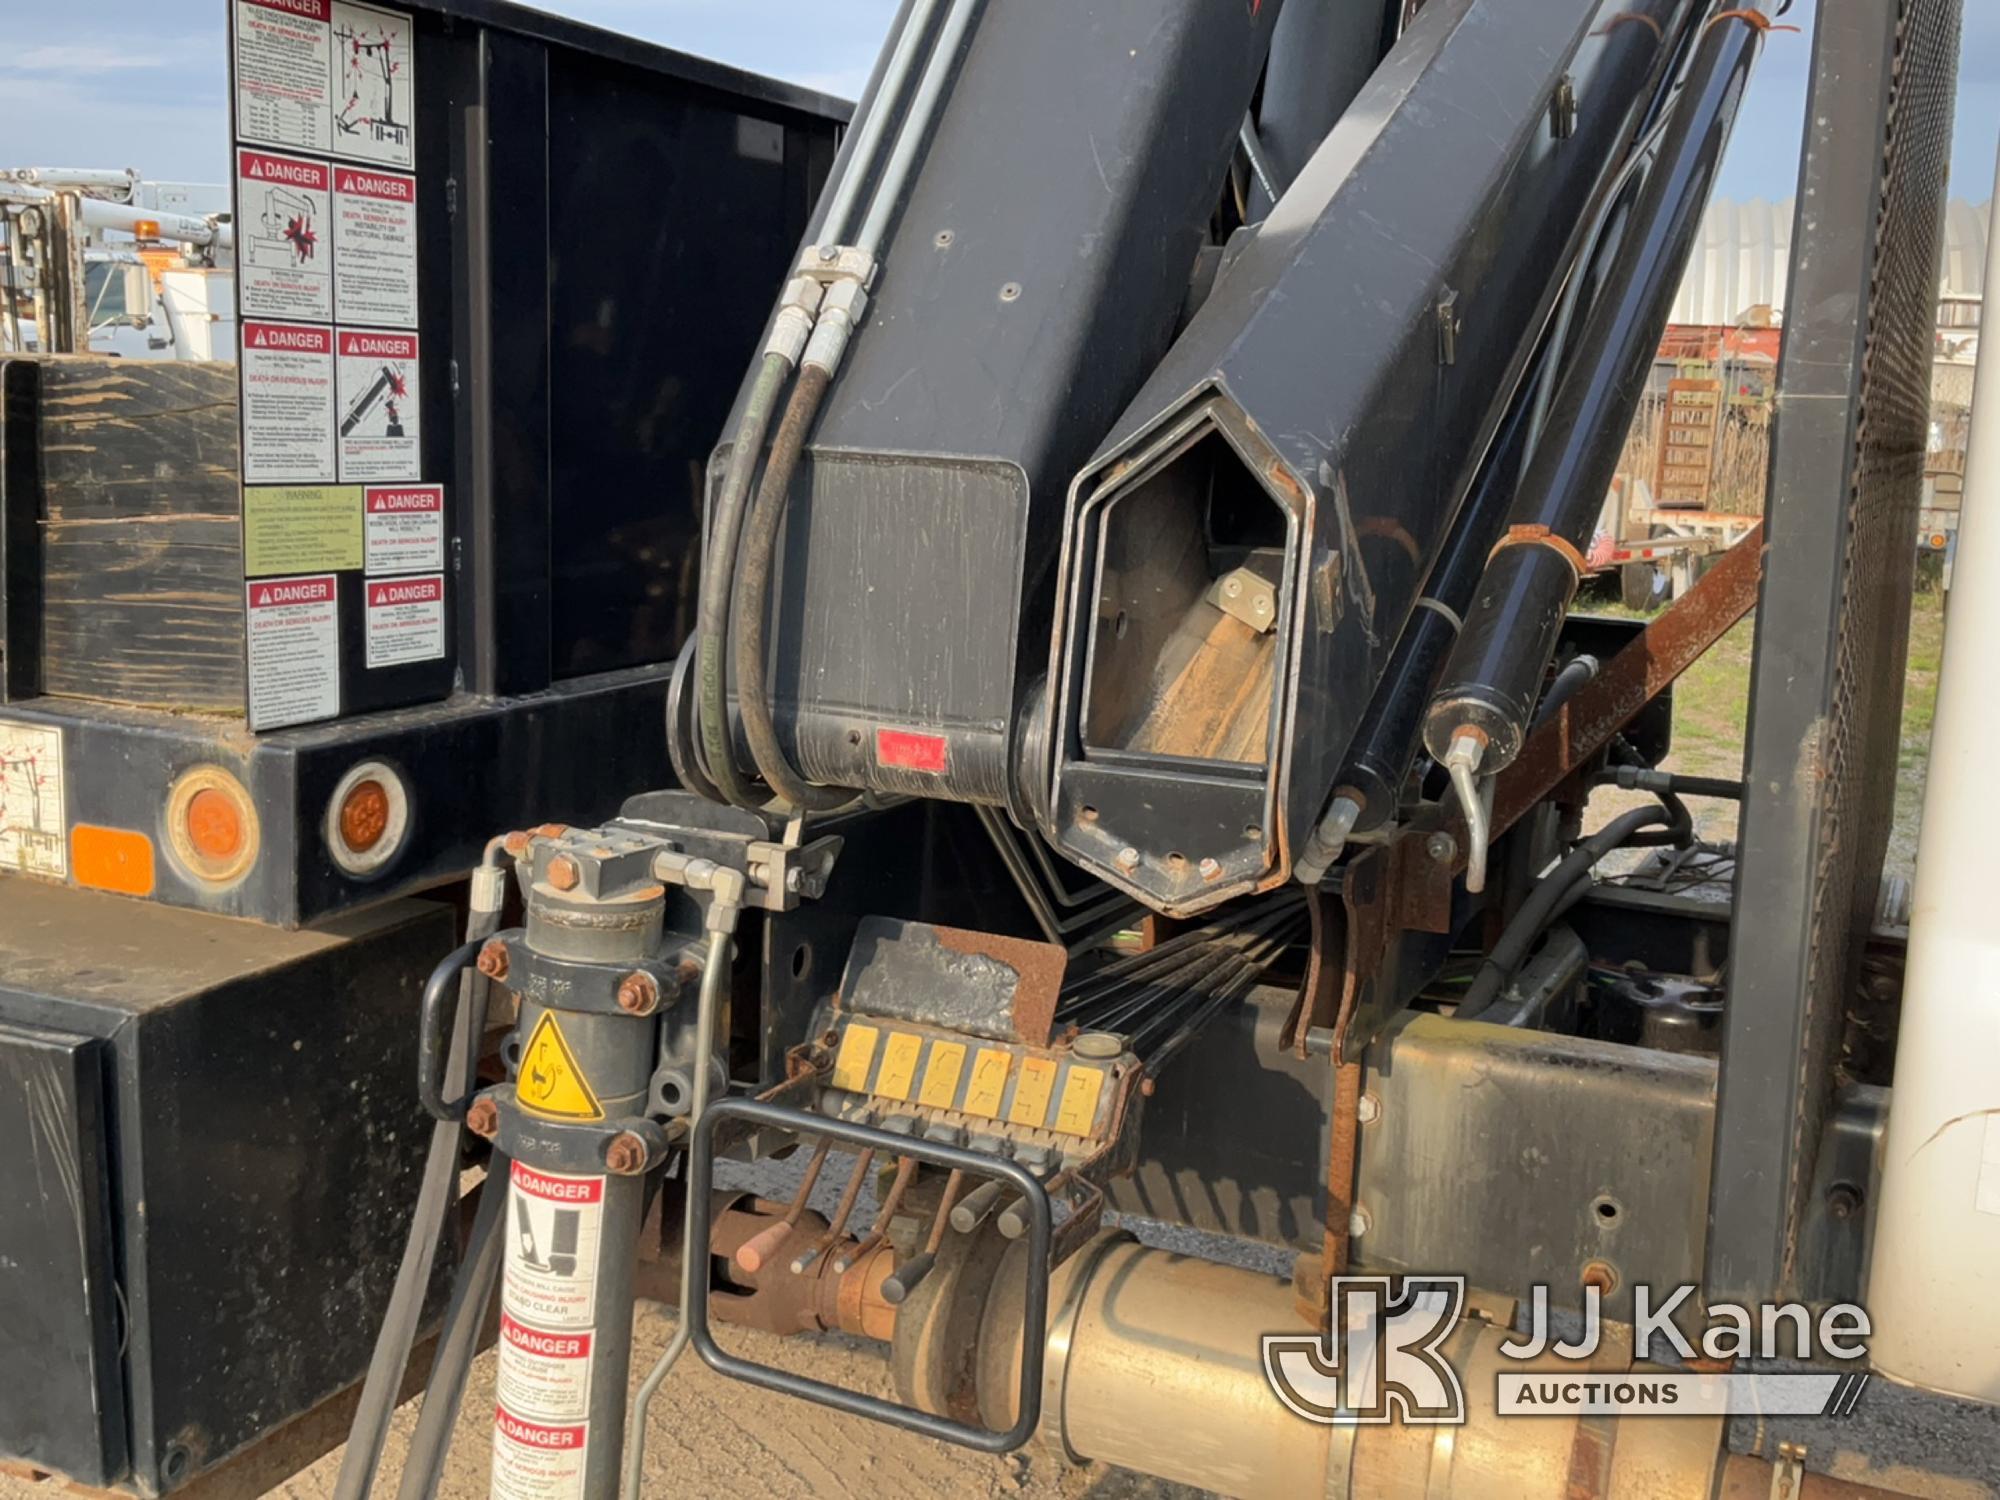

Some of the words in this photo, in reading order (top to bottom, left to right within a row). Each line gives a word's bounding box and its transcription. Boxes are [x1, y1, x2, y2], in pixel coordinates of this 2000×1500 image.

[257, 0, 322, 16] NGER
[265, 160, 321, 185] DANGER
[356, 176, 407, 197] DANGER
[269, 330, 324, 349] DANGER
[360, 338, 410, 355] DANGER
[387, 494, 435, 509] DANGER
[274, 583, 327, 602] DANGER
[389, 584, 436, 601] DANGER
[520, 1173, 590, 1199] DANGER
[533, 1301, 569, 1315] CLEAR
[511, 1328, 580, 1355] DANGER
[507, 1421, 574, 1446] DANGER
